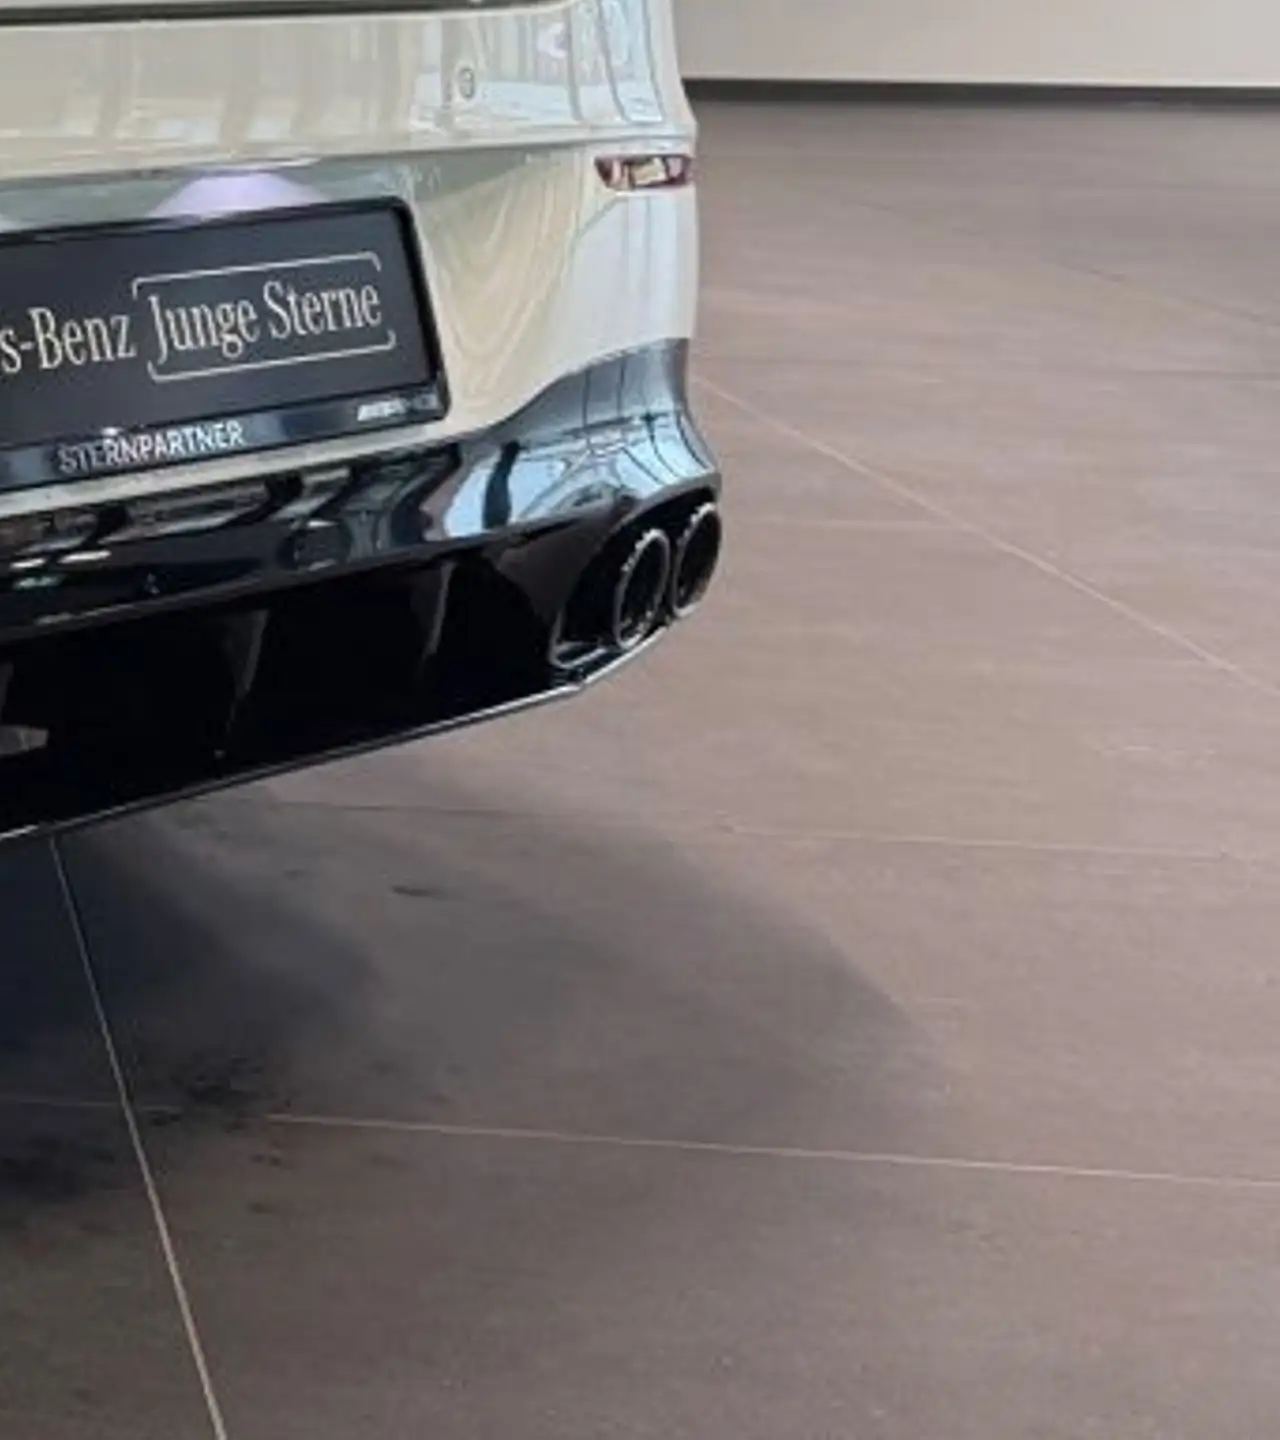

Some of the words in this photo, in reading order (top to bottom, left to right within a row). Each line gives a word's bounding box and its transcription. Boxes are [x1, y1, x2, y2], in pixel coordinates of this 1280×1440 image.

[147, 294, 258, 365] Junge
[262, 280, 383, 340] Sterne
[56, 419, 246, 474] STERNPARTNER
